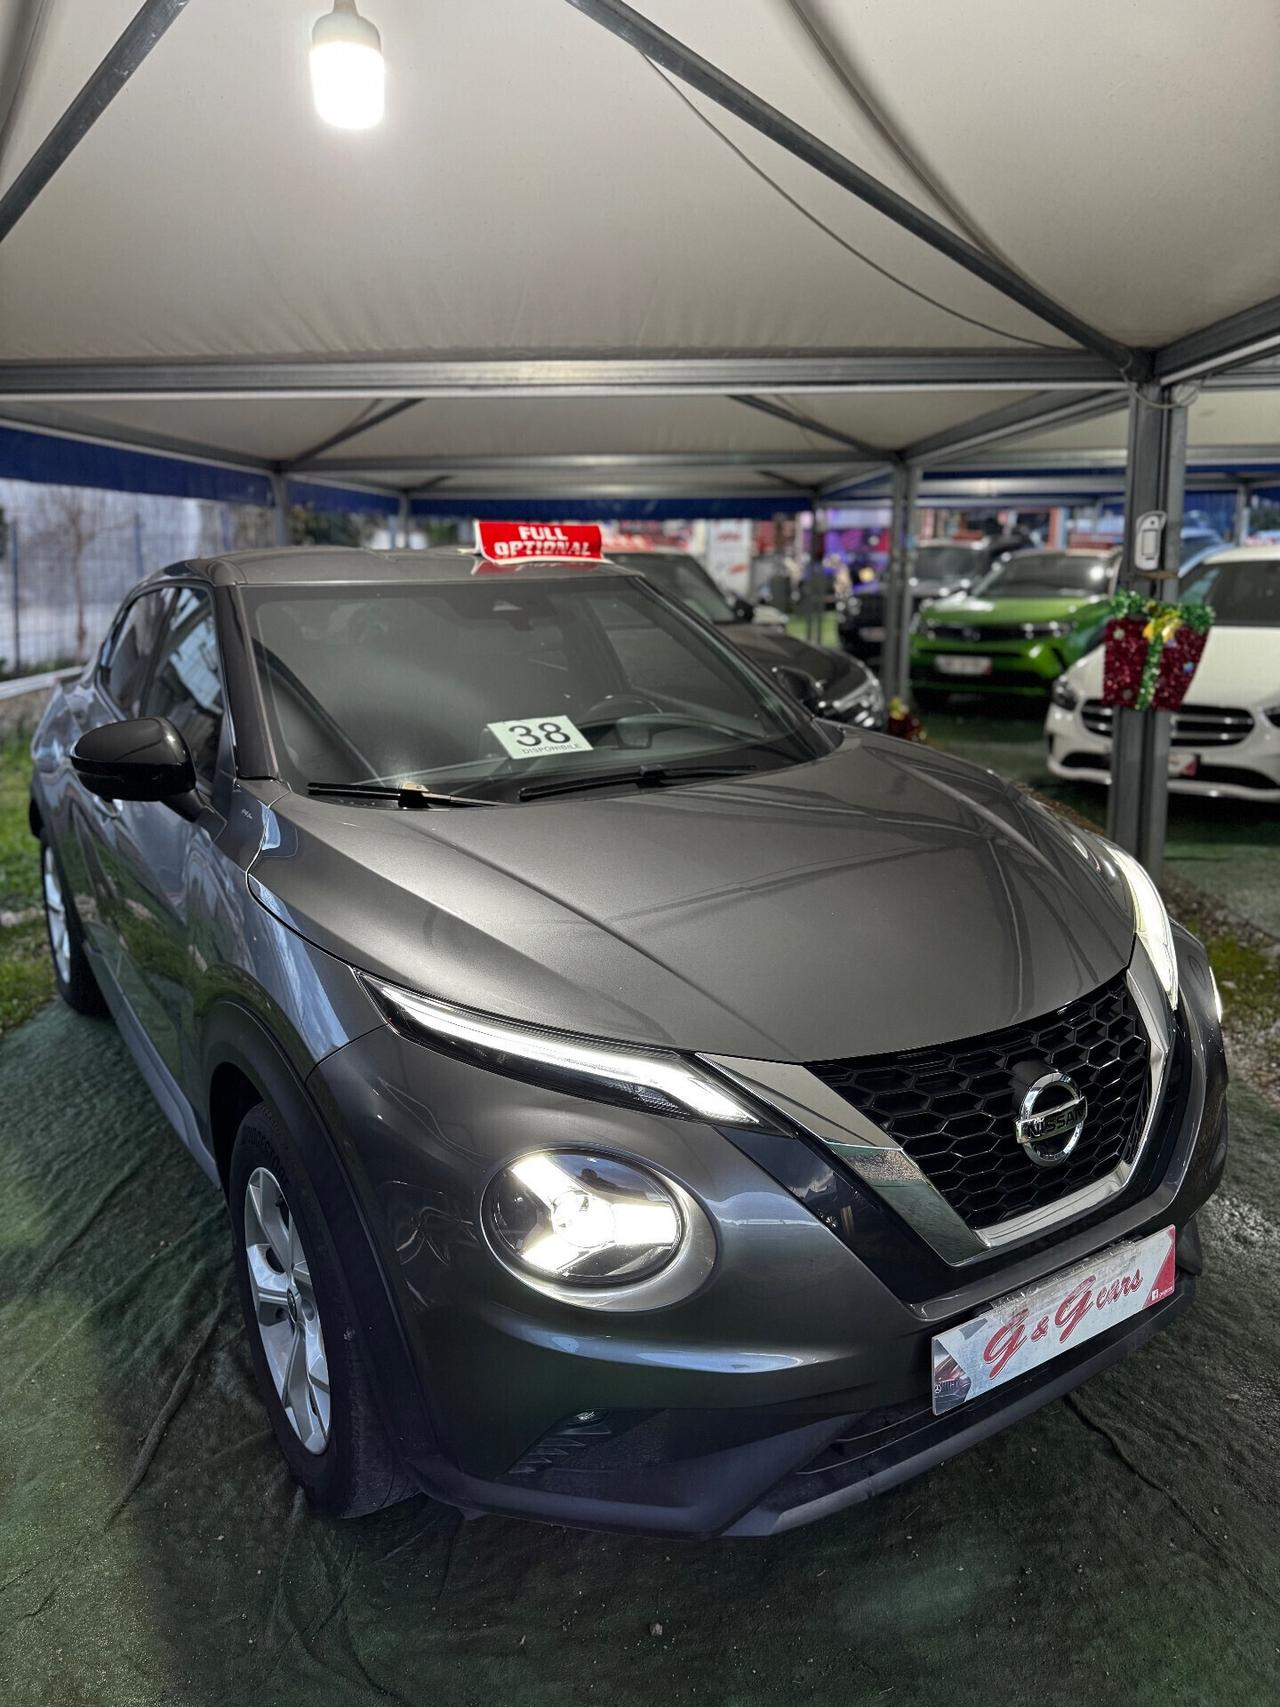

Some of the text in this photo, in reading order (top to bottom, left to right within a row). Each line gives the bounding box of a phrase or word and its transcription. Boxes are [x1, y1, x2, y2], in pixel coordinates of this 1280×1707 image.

[518, 525, 569, 541] FULL
[493, 540, 592, 556] OPTIONAL
[508, 721, 572, 747] 38
[522, 743, 579, 755] DISPONIBILE
[1024, 1106, 1084, 1138] NISSAN
